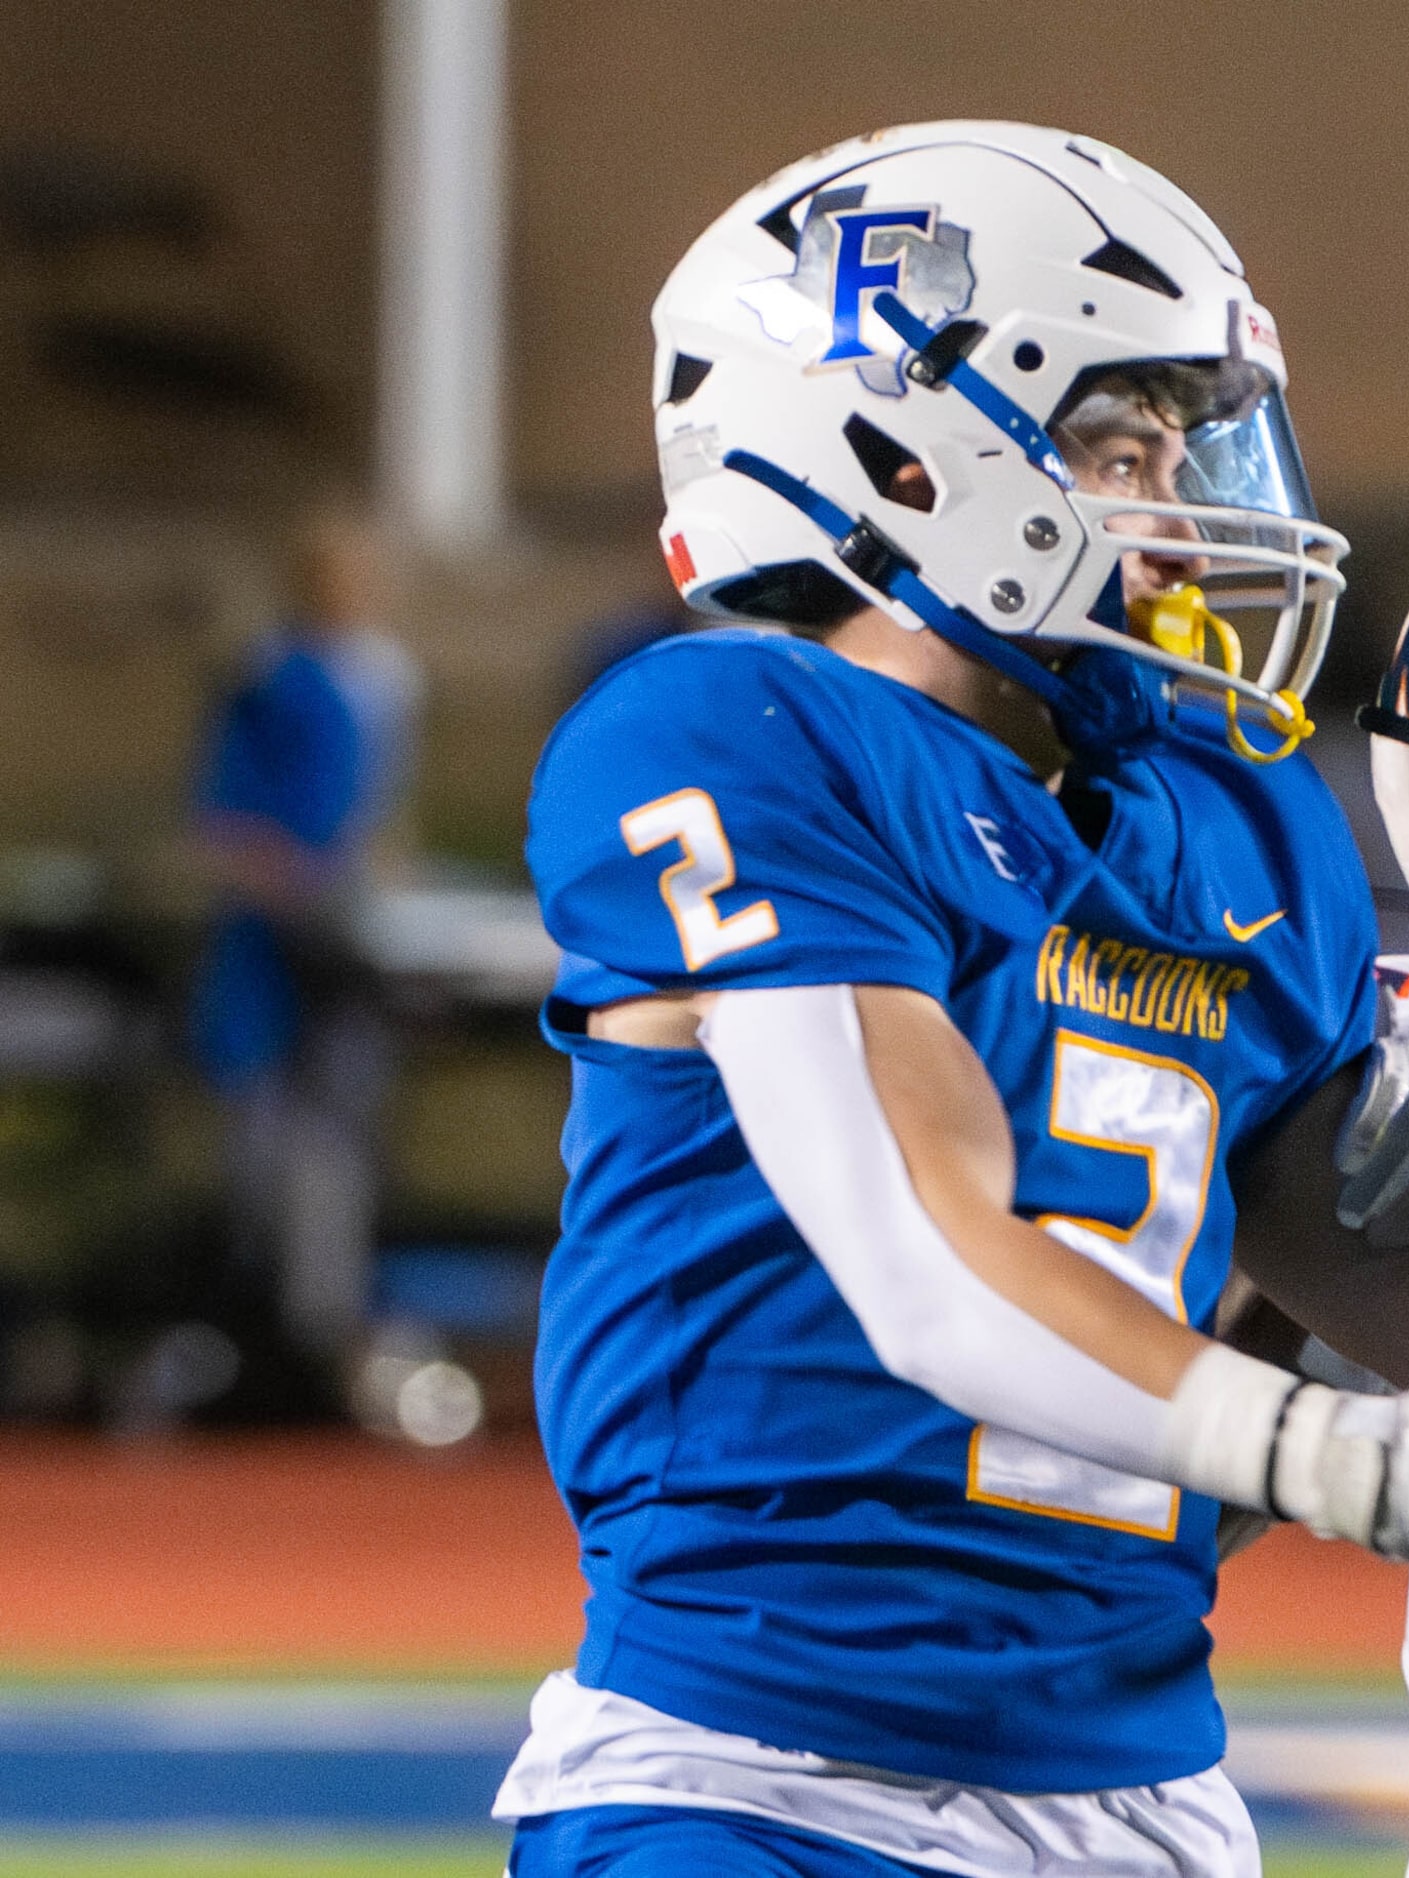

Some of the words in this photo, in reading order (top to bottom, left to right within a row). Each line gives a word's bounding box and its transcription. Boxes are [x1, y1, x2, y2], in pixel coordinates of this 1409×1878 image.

[803, 203, 941, 377] F
[620, 787, 780, 973] 2
[1036, 923, 1250, 1043] RACCOONS
[966, 1028, 1221, 1542] 2
